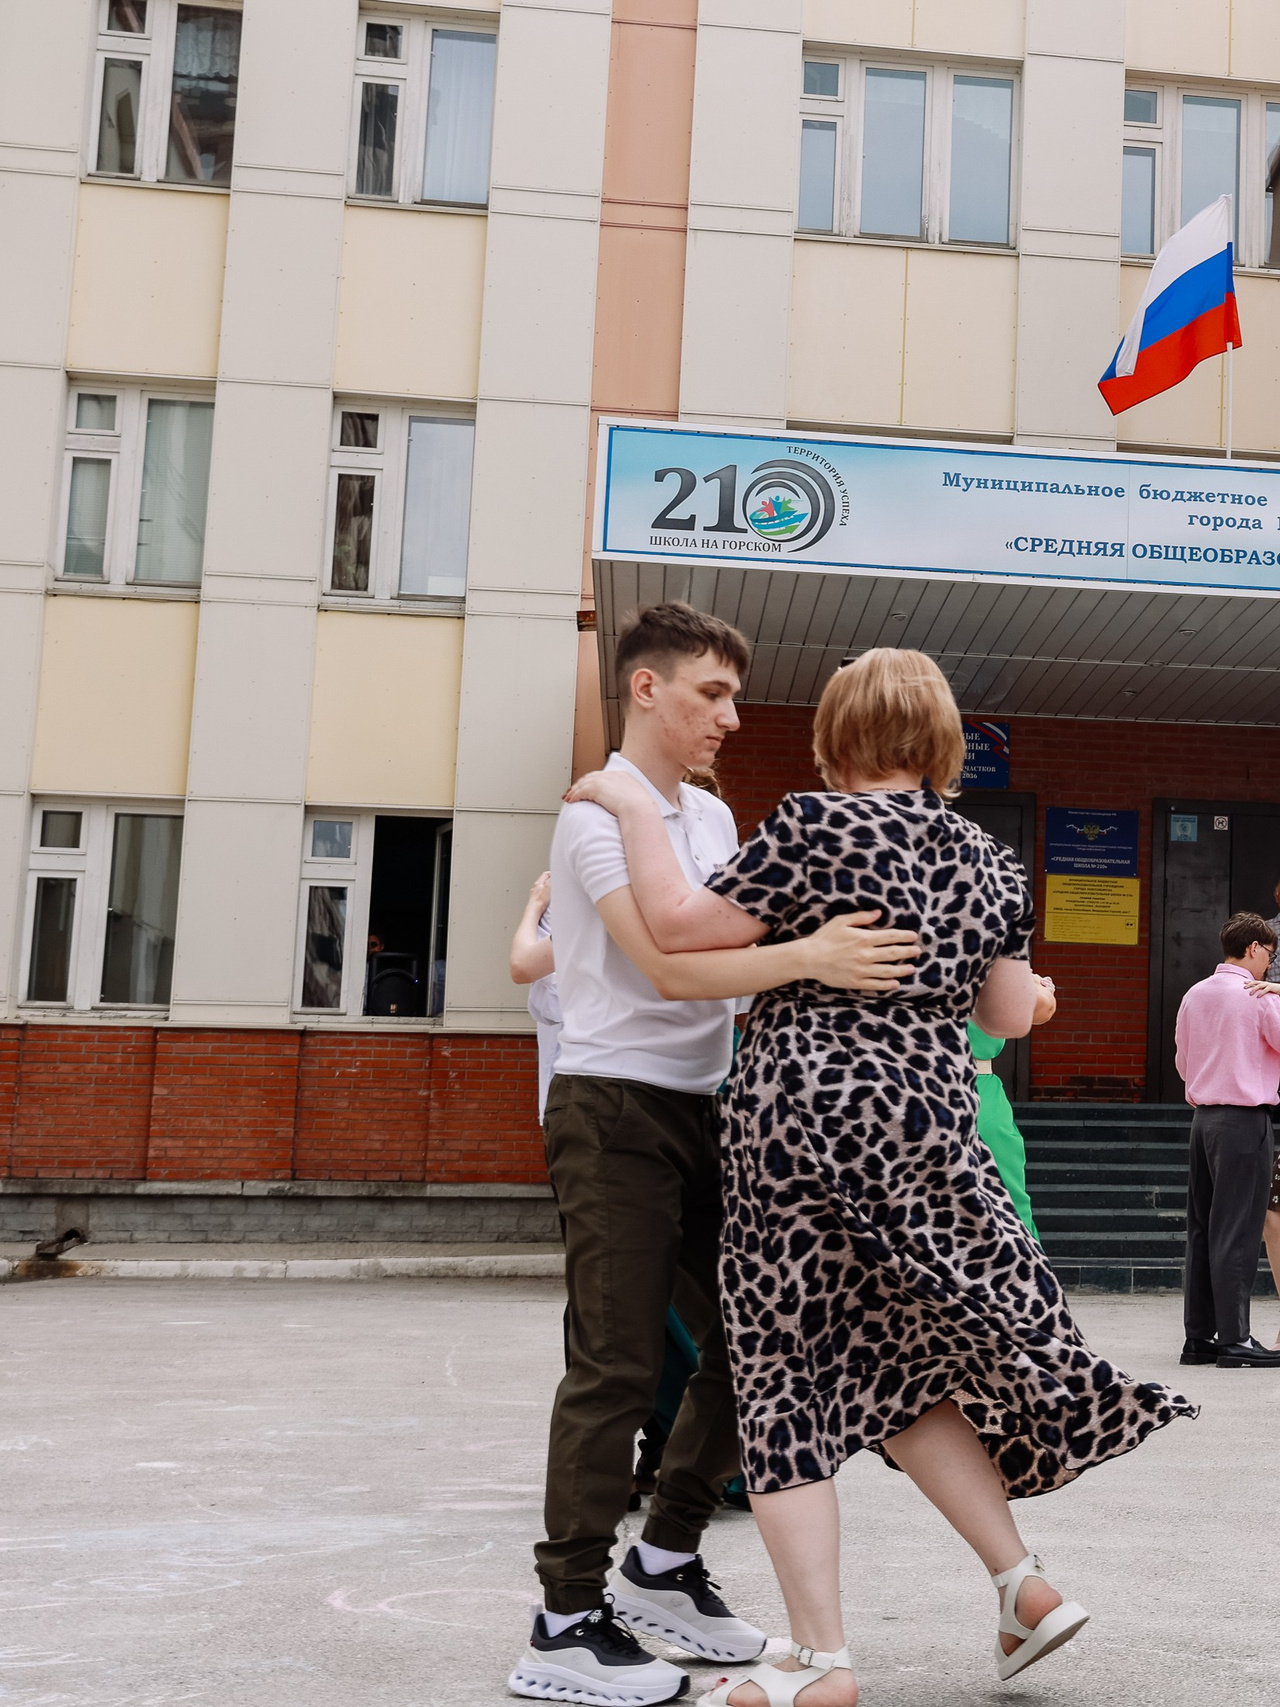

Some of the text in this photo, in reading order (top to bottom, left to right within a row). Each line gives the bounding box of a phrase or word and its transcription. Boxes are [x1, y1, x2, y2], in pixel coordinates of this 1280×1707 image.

[786, 446, 850, 527] ТЕРРИТОРИЯ УСПЕХА
[942, 471, 1126, 498] Муниципальное
[1138, 483, 1268, 507] бюджетное
[651, 459, 836, 553] 210
[1187, 513, 1264, 531] города
[649, 535, 782, 553] ШКОЛА НА ГОРСКОМ
[1005, 535, 1126, 558] «СРЕДНЯЯ
[963, 765, 997, 773] ЧАСТКОВ
